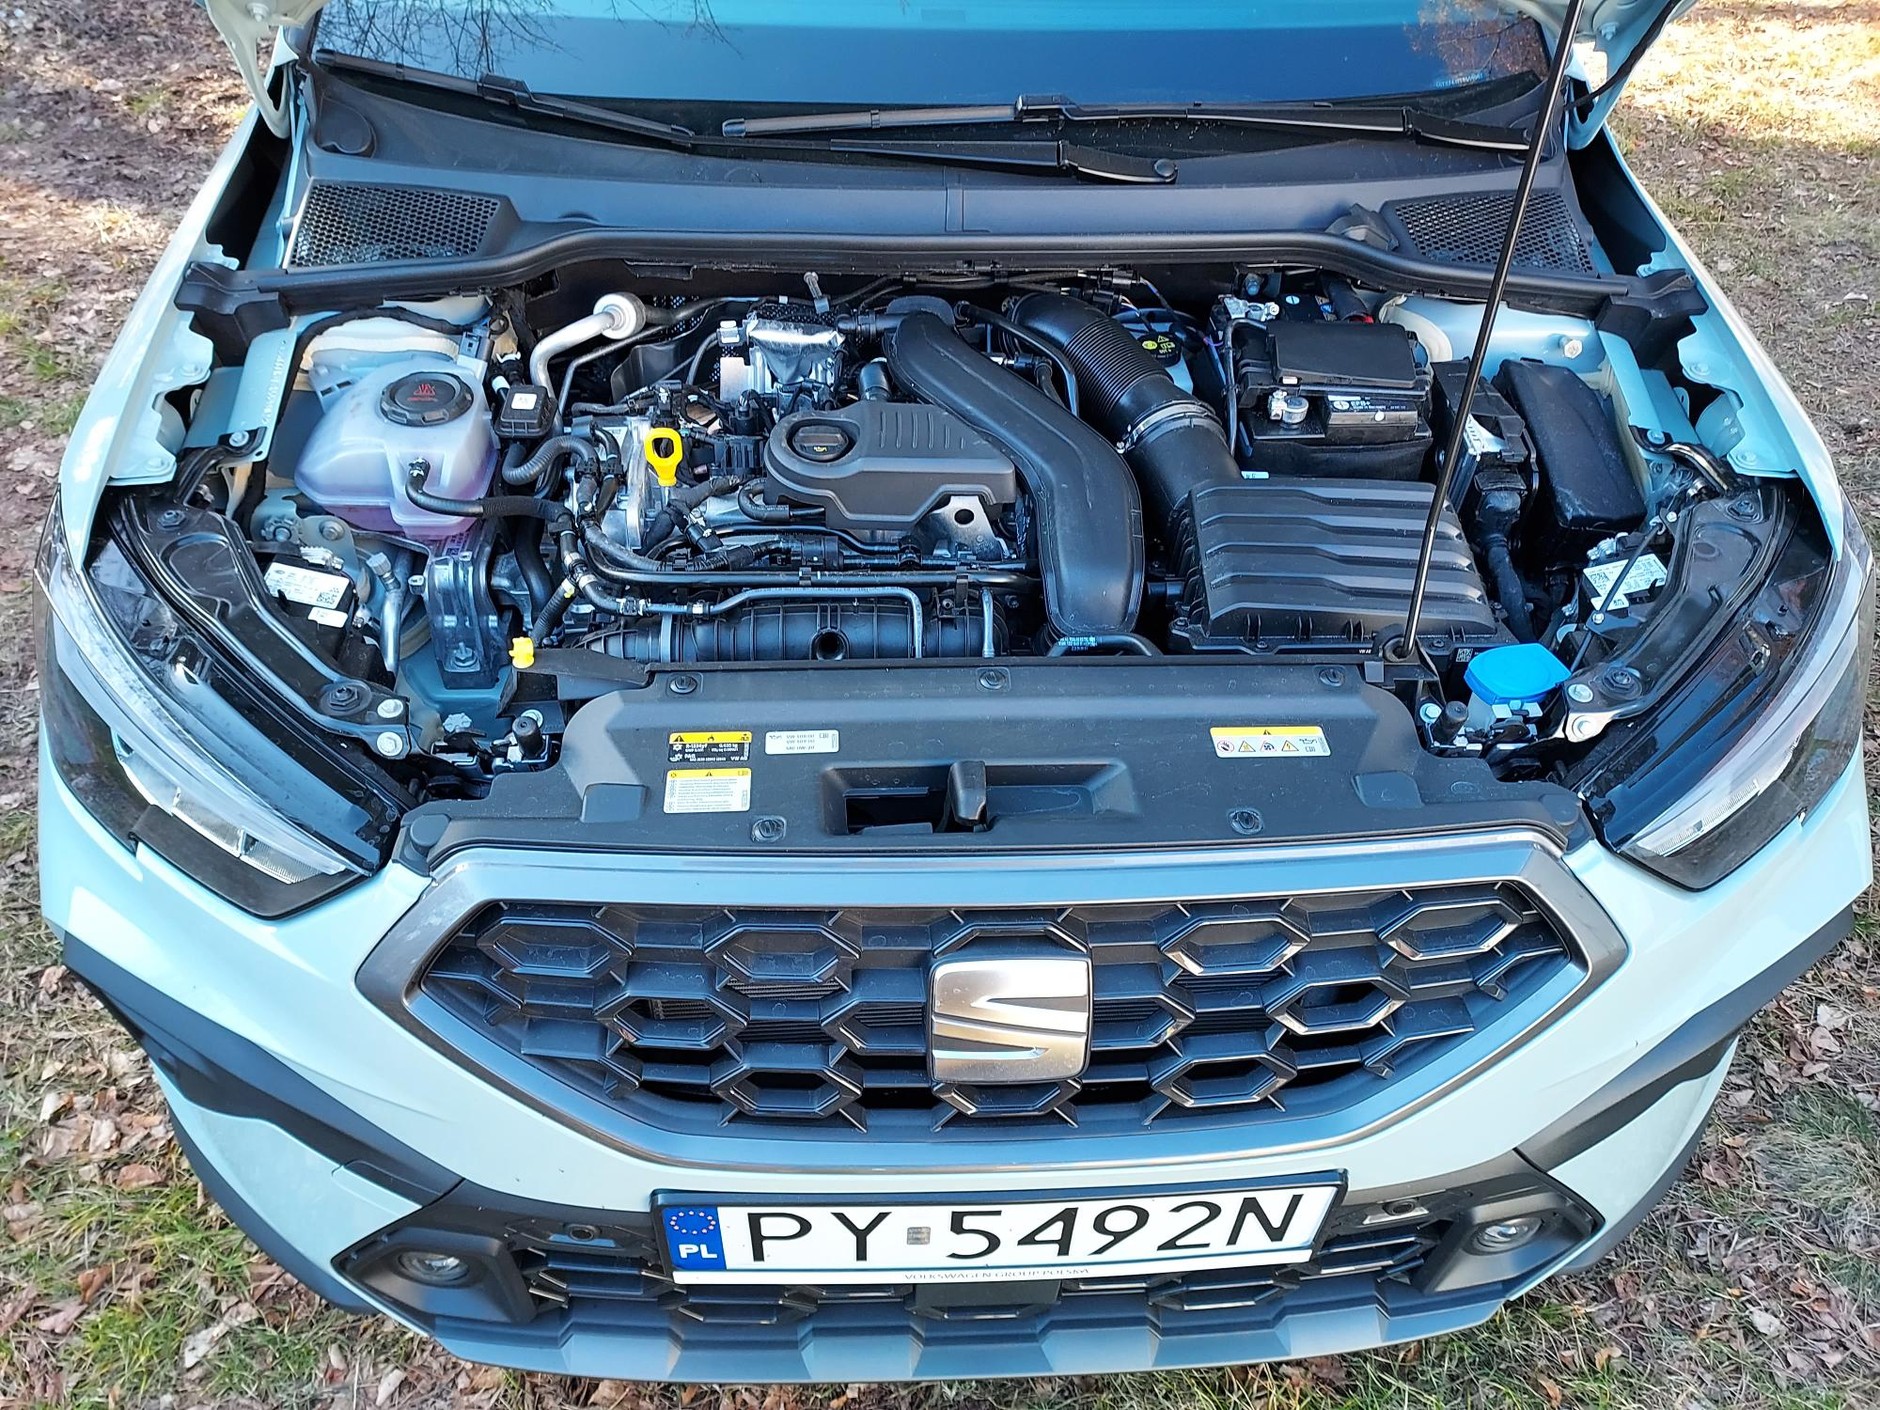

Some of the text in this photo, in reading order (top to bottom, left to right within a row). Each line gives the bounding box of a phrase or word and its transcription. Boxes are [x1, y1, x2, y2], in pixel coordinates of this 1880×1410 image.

[747, 1193, 1304, 1262] PY 5492N
[678, 1243, 718, 1259] PL
[904, 1271, 992, 1280] VOLKSWAGEN
[1042, 1268, 1090, 1276] POLSKA
